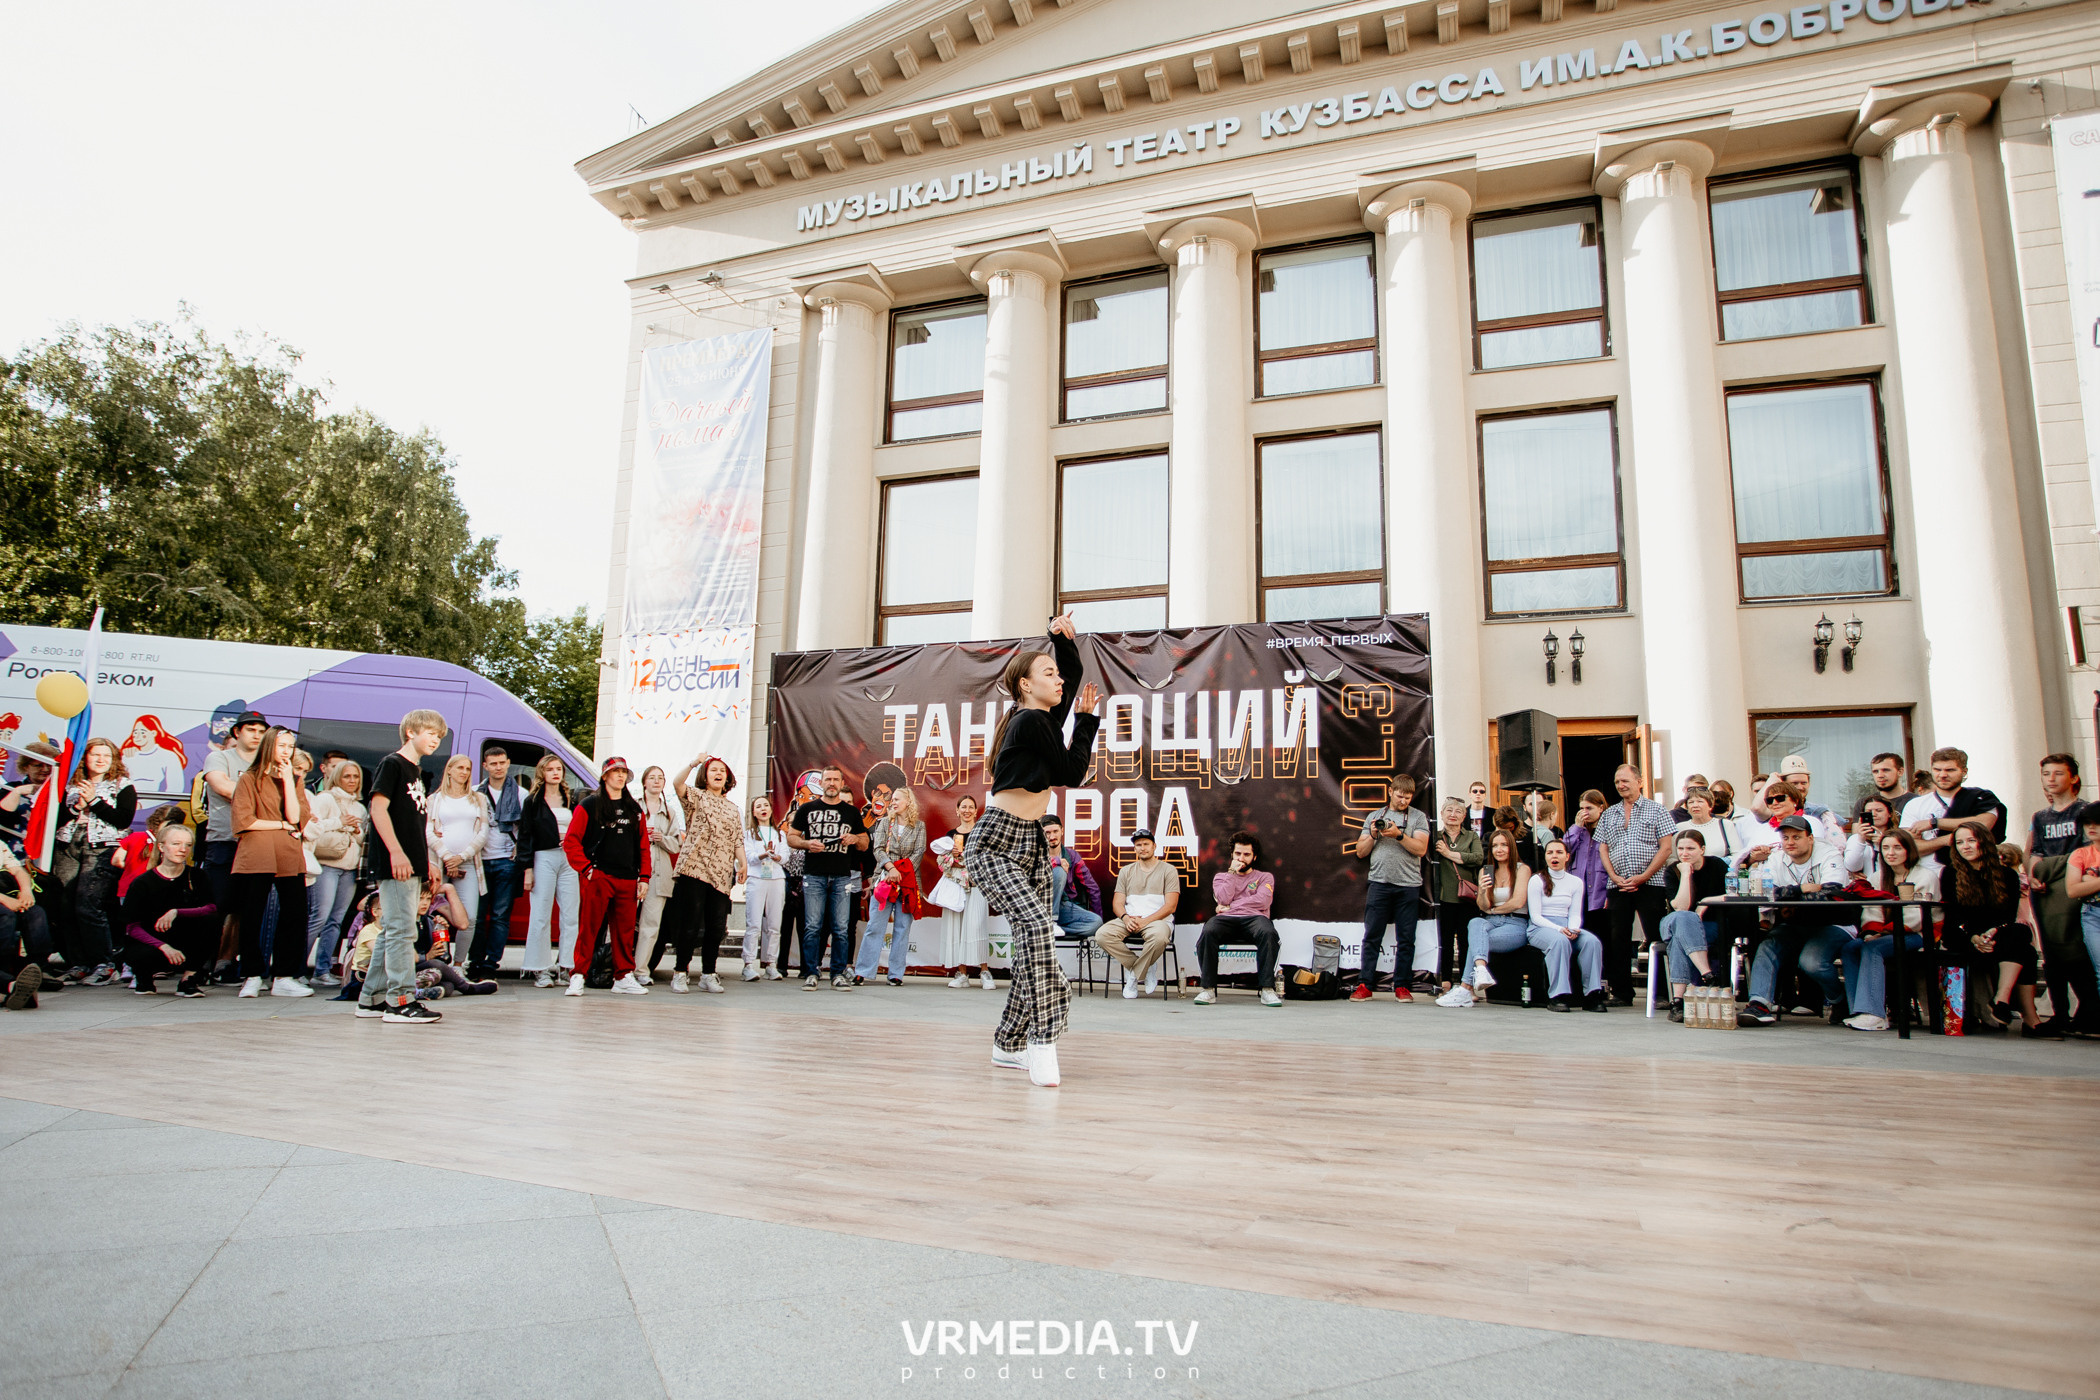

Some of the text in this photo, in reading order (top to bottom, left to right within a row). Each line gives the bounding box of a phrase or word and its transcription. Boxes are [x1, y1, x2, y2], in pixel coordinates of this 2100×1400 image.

[797, 0, 1986, 231] МУЗЫКАЛЬНЫЙ ТЕАТР КУЗБАССА ИМ.А.К.БОБРО
[1266, 632, 1393, 649] #ВРЕМЯ_ПЕРВЫХ
[31, 646, 160, 663] 8-800-10-800 RT.RU
[657, 655, 711, 675] ДЕНЬ
[655, 670, 740, 693] РОССИИ
[884, 670, 1319, 759] ТАНЮЩИЙ
[985, 787, 1199, 857] РОД
